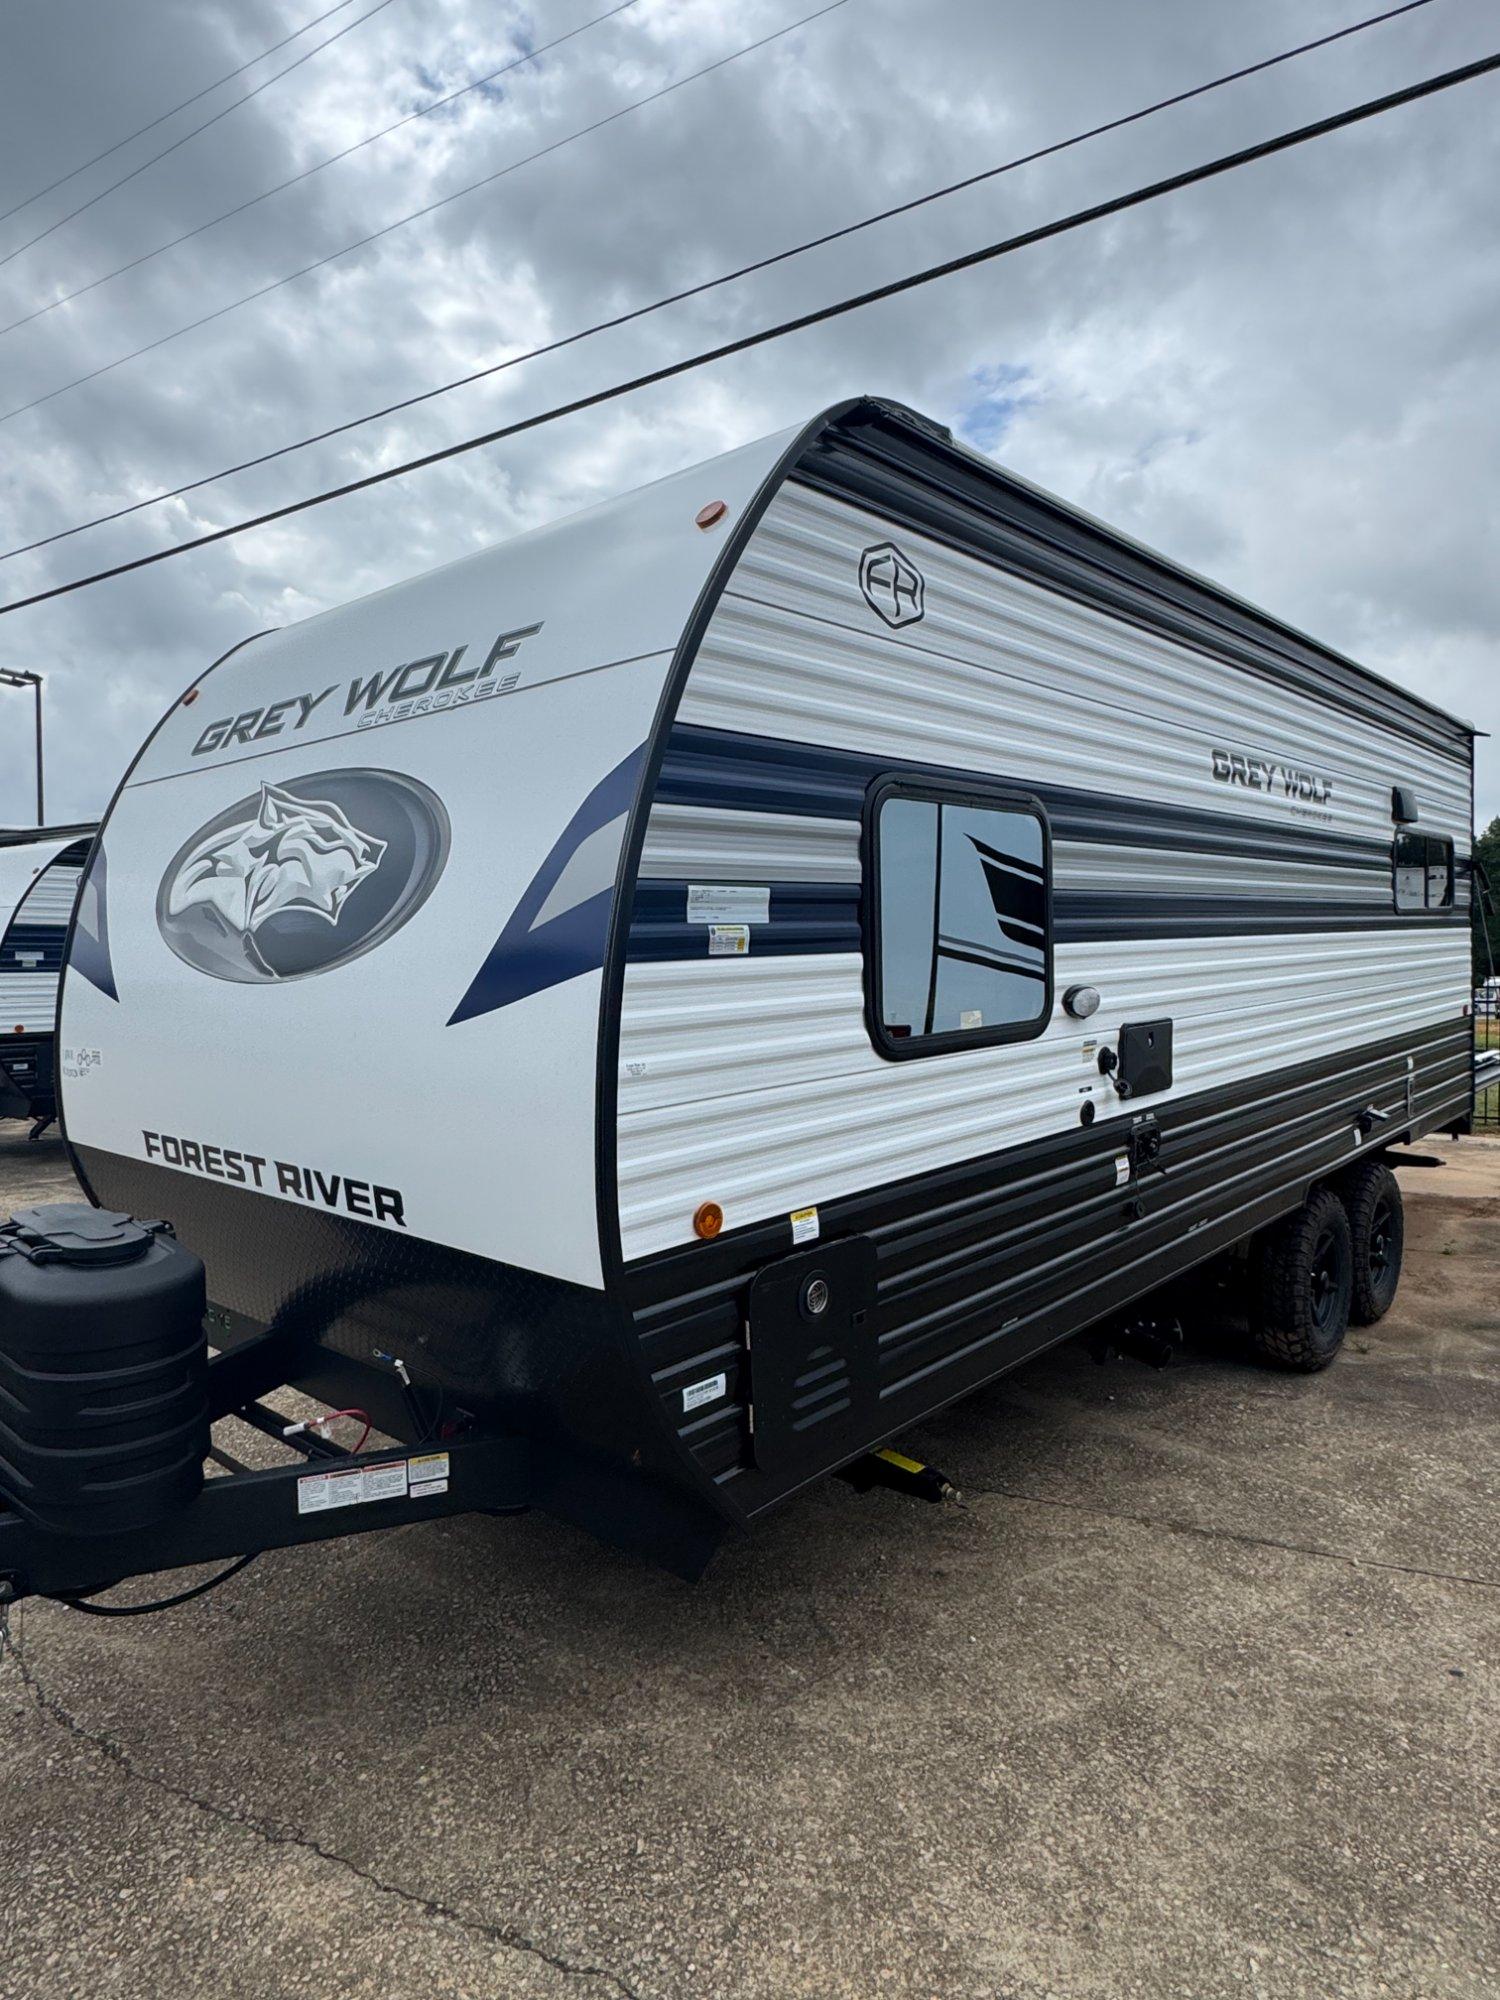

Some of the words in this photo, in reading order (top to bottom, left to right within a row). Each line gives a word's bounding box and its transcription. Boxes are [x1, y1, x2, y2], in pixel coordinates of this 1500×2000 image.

[191, 684, 341, 757] GREY
[343, 620, 545, 717] WOLF
[358, 673, 521, 729] CHEROKEE
[1212, 748, 1276, 793] GREY
[1281, 767, 1333, 805] WOLF
[141, 1130, 266, 1188] FOREST
[273, 1160, 407, 1228] RIVER
